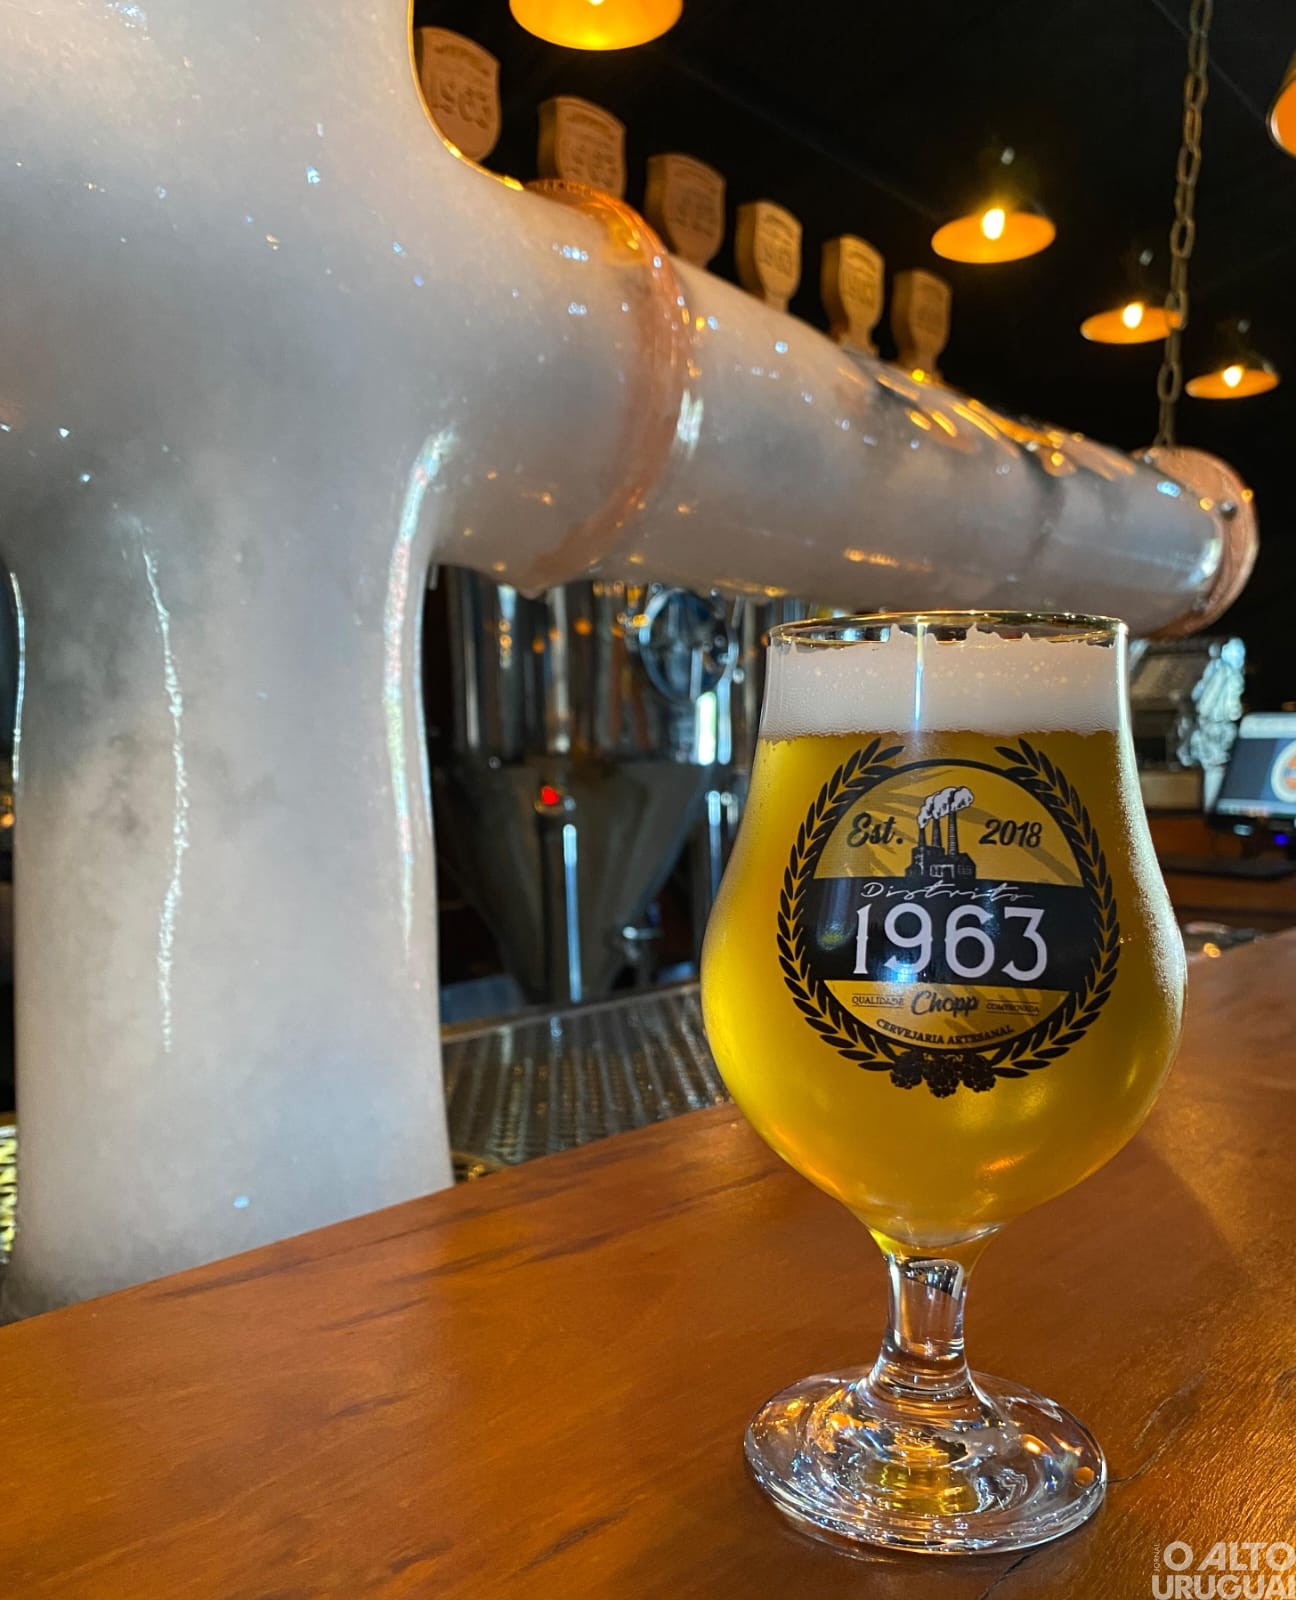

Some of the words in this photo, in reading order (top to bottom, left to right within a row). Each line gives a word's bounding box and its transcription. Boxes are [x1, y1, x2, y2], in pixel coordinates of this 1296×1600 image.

[848, 812, 903, 847] Est.
[979, 819, 1042, 848] 2018
[861, 880, 1034, 900] Distrito
[853, 903, 1048, 982] 1963
[911, 990, 979, 1018] Chopp
[876, 1018, 945, 1045] CERVEJARIA
[946, 1024, 1015, 1045] ARTESANAL
